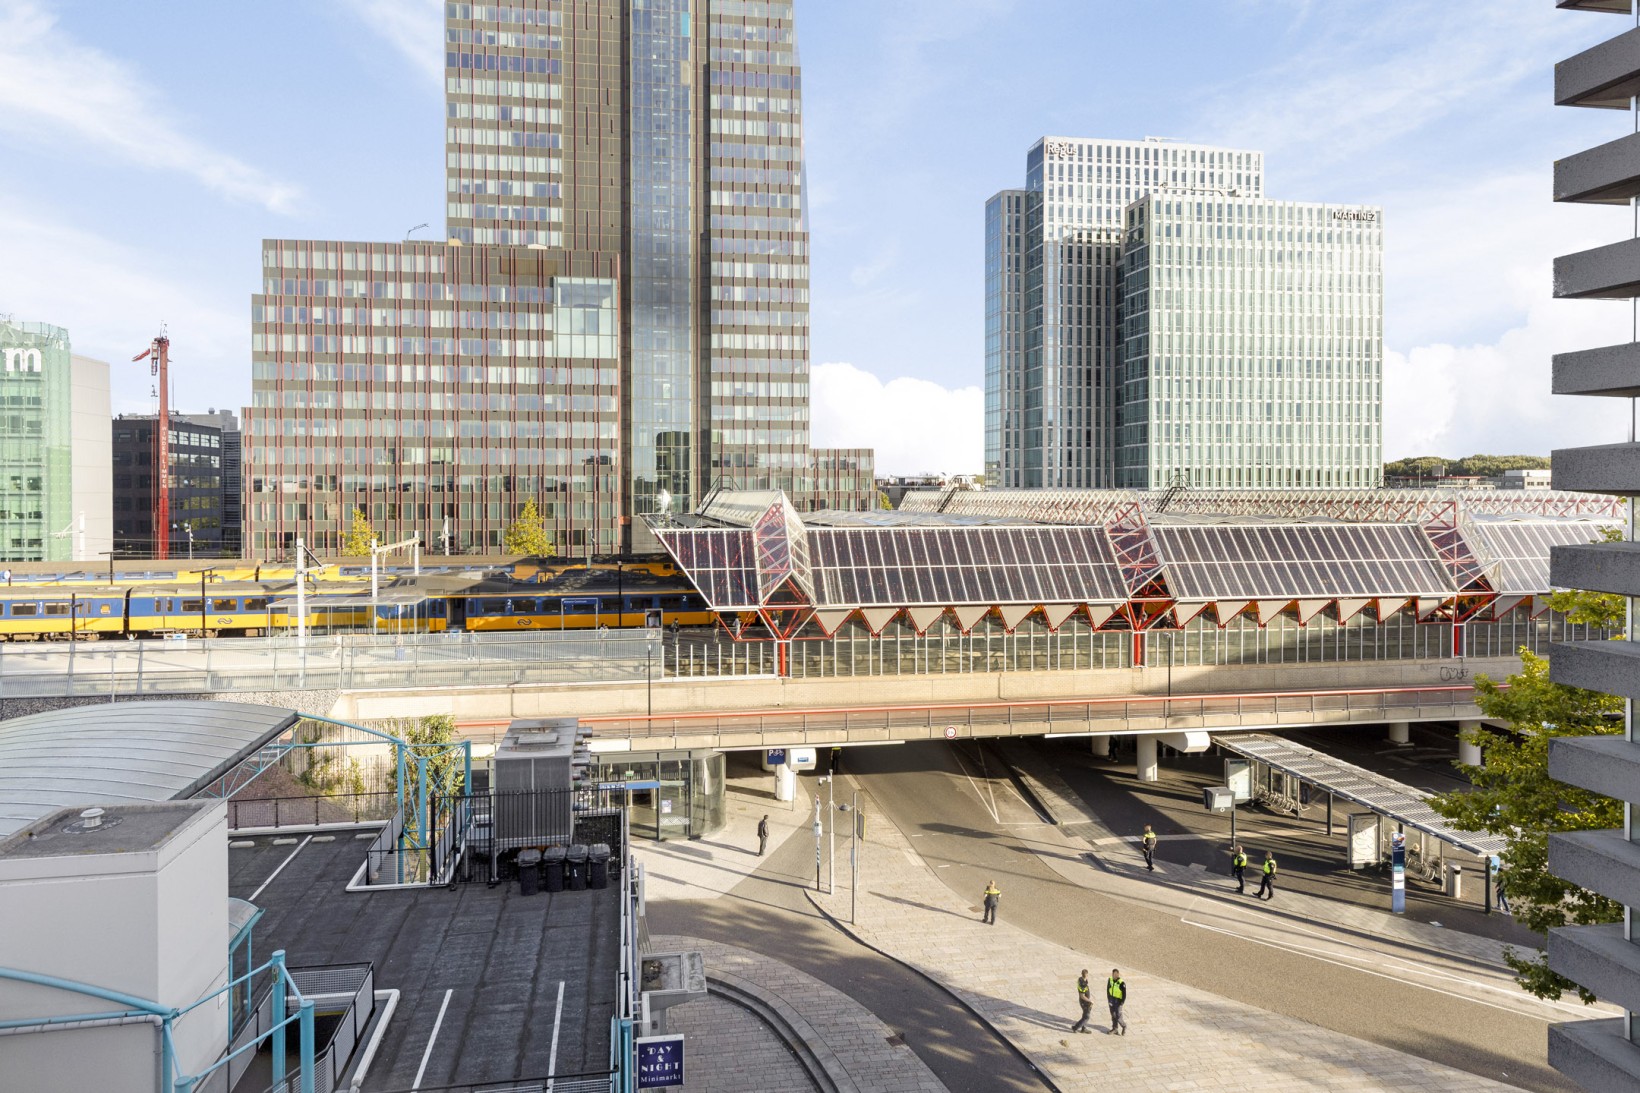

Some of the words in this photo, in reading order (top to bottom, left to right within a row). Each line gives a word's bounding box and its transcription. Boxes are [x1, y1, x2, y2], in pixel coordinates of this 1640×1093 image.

[1048, 142, 1077, 159] Regus
[1332, 211, 1376, 222] MARTINEZ
[2, 348, 42, 372] m
[647, 1046, 672, 1054] DAY
[641, 1062, 680, 1072] NIGHT
[641, 1074, 681, 1082] Minimarkt
